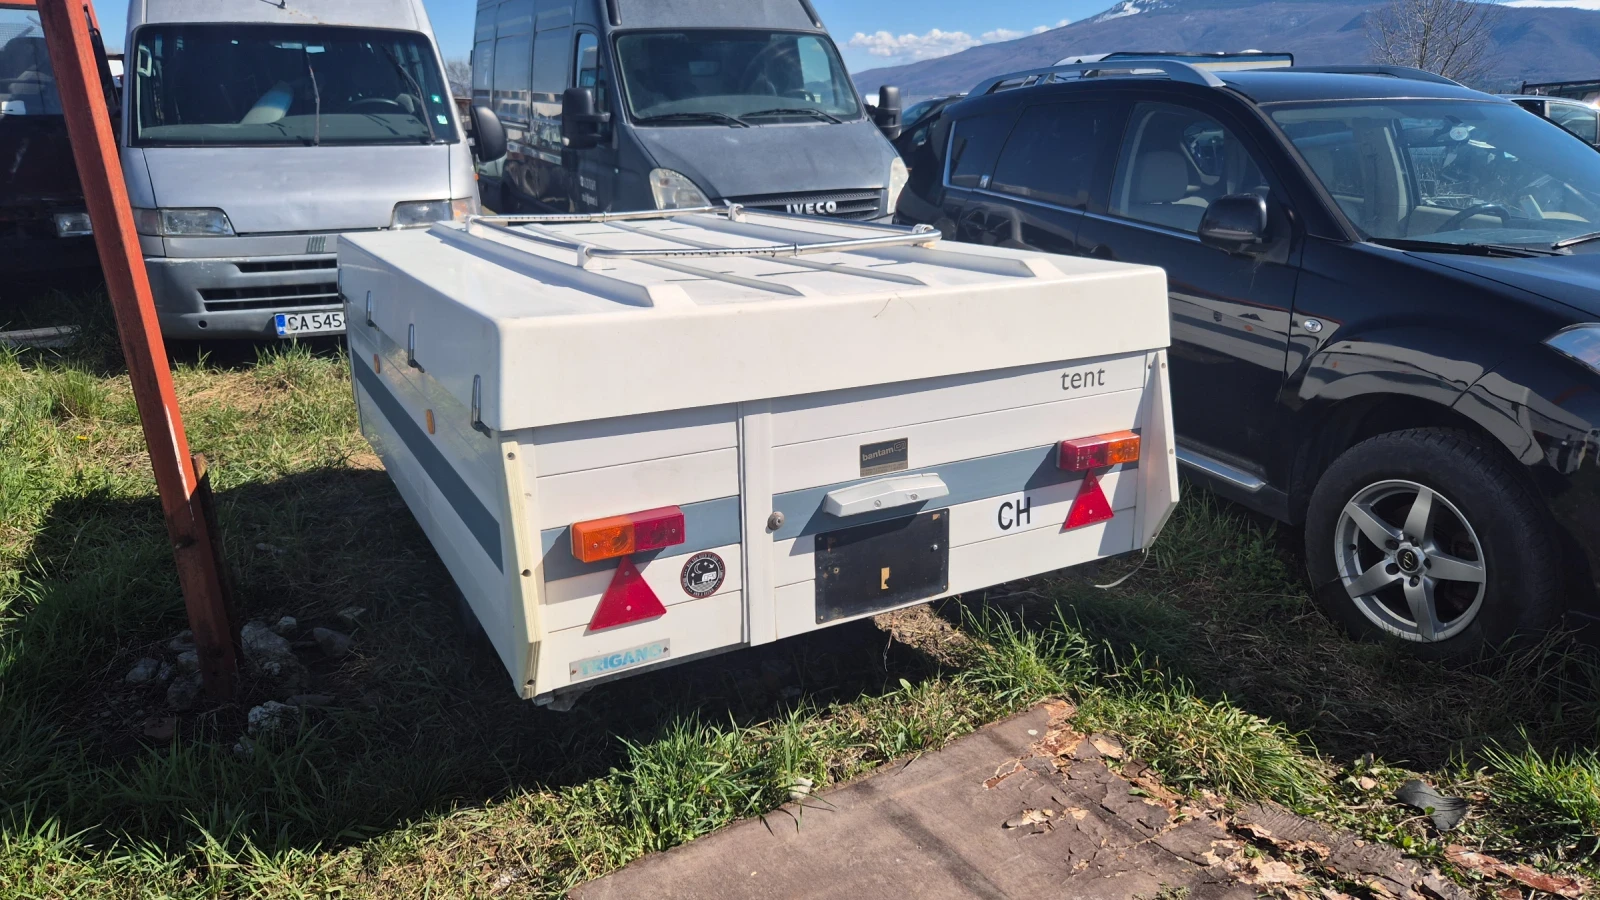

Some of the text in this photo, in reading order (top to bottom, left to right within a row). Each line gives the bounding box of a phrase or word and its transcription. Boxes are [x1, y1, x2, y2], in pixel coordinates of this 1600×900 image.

[786, 201, 837, 215] IVECO
[287, 314, 346, 330] CA 545
[1061, 368, 1105, 390] tent
[862, 446, 895, 462] bantam
[997, 496, 1031, 530] CH
[580, 643, 663, 676] TRIGANO
